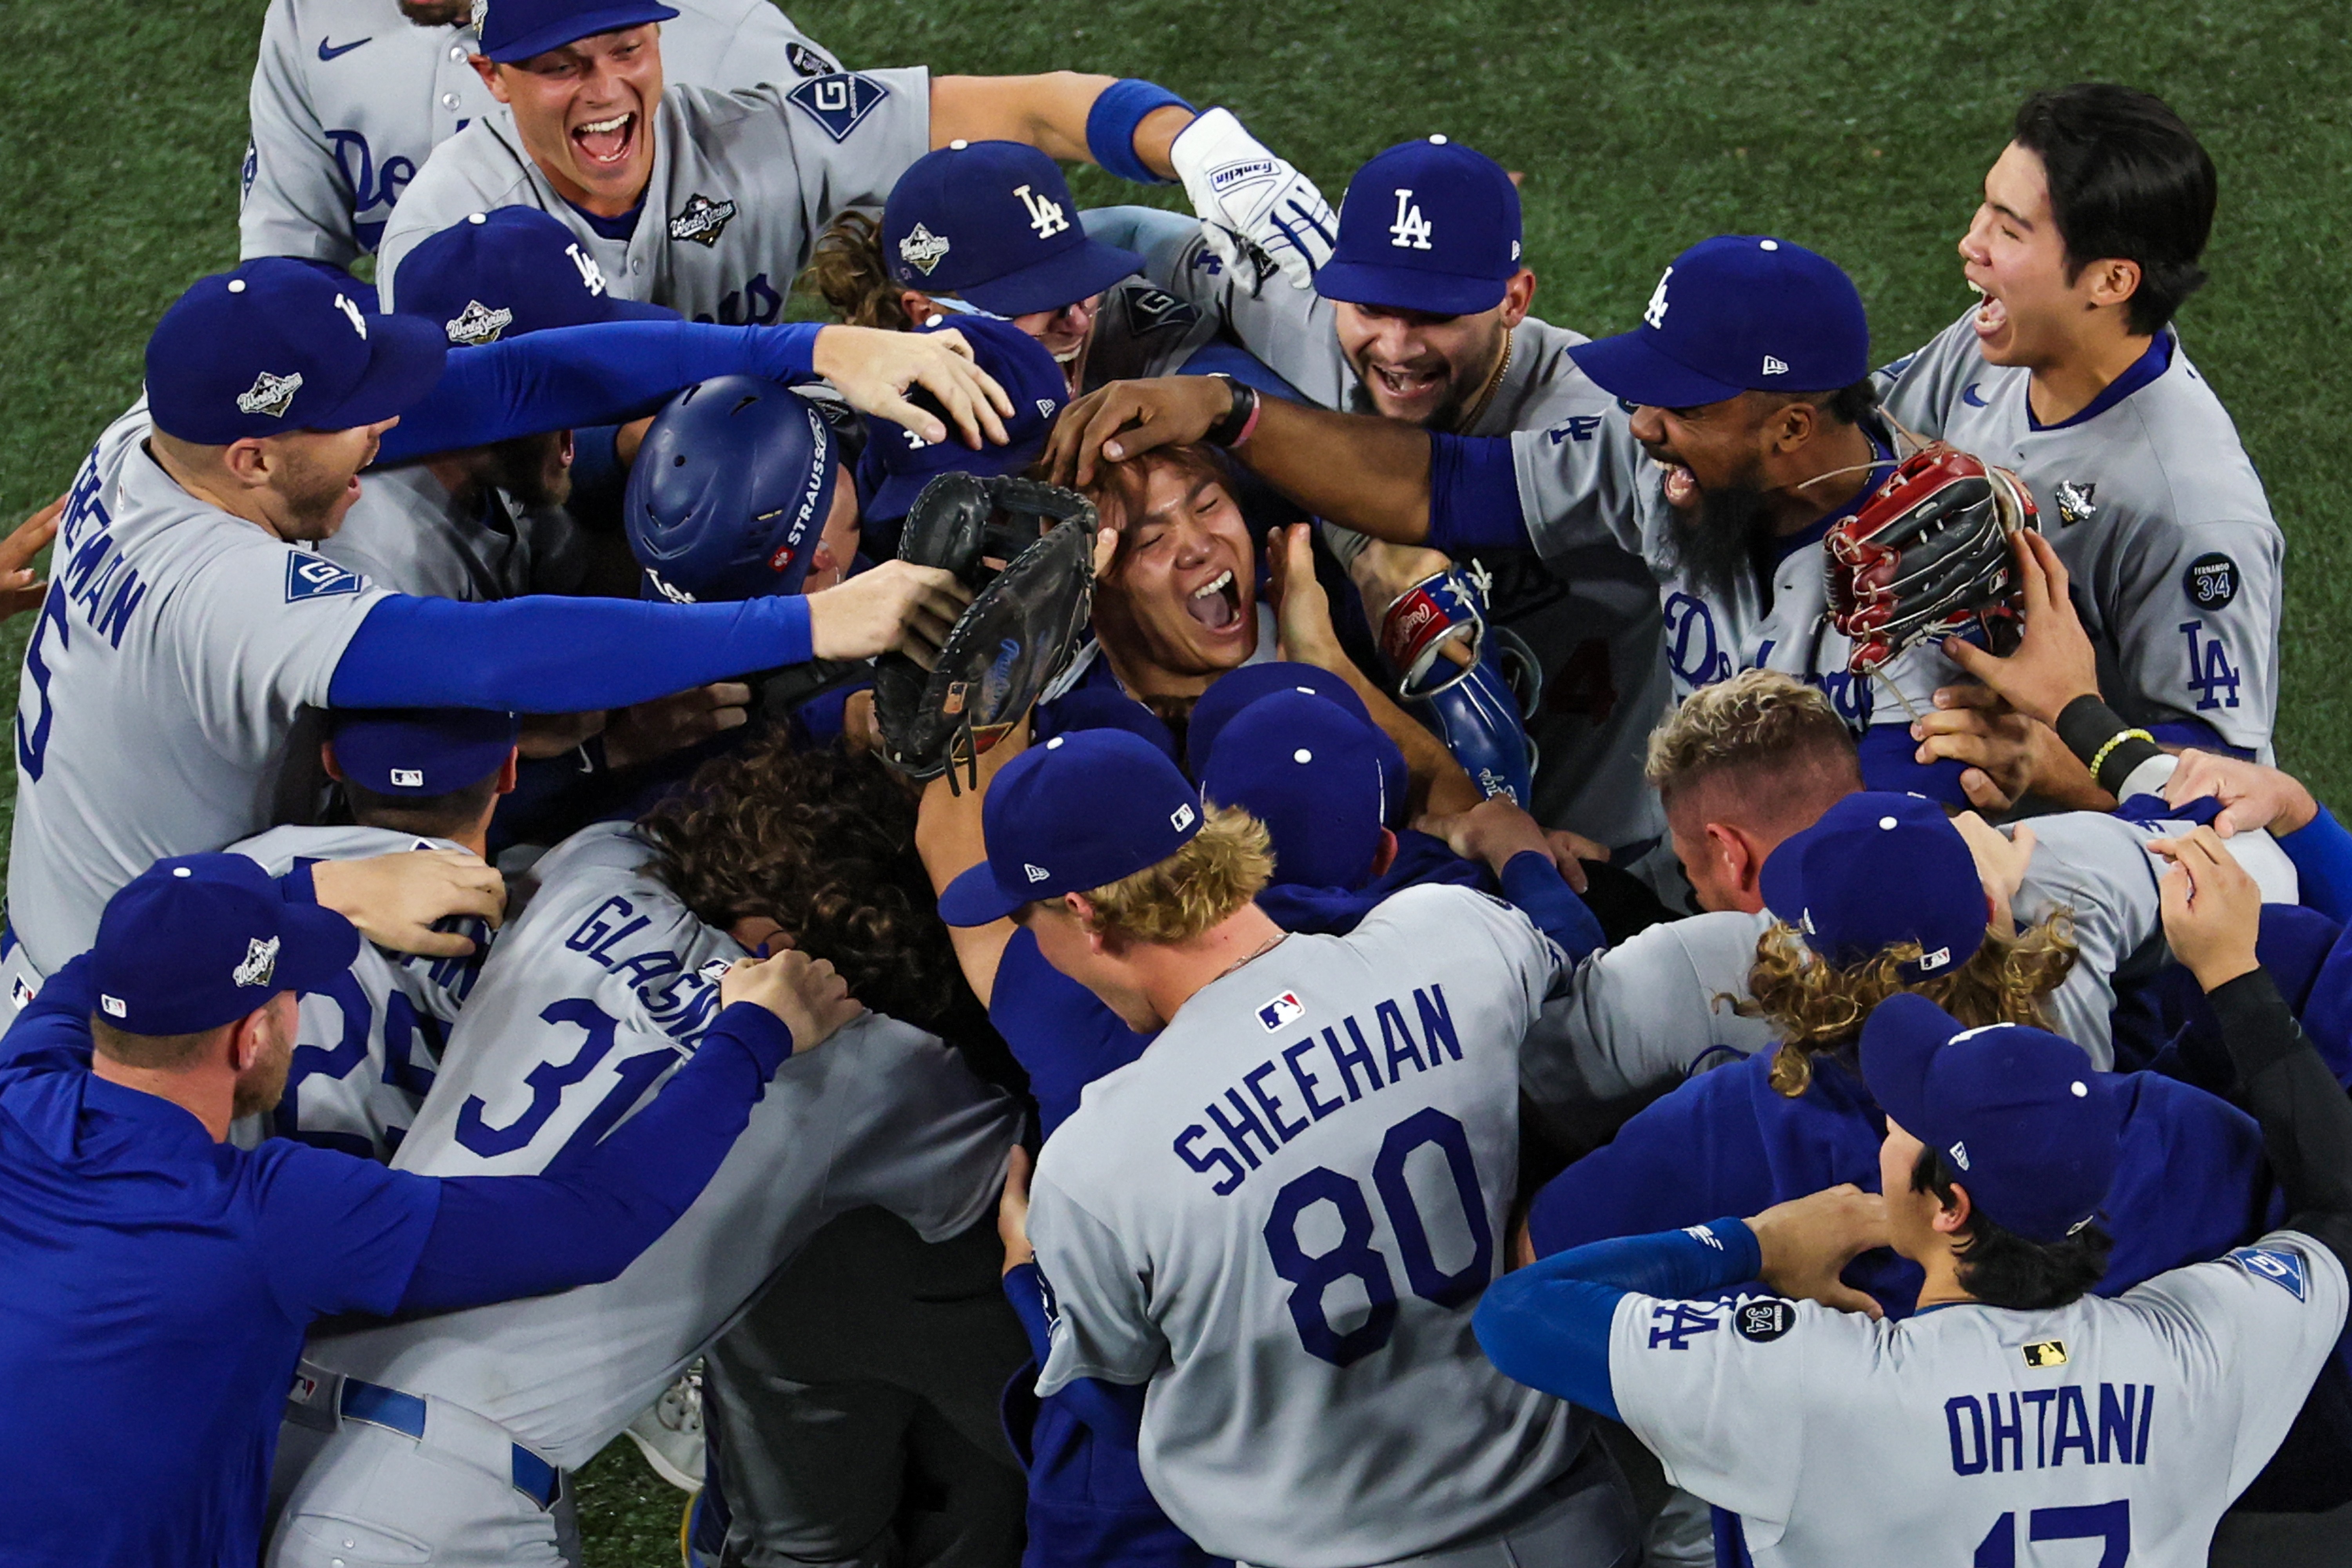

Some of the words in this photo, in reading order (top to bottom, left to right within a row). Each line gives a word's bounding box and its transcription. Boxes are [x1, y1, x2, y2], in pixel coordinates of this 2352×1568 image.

[1013, 184, 1069, 240] LA
[1390, 189, 1432, 250] LA
[566, 243, 606, 296] LA
[1644, 266, 1673, 329] LA
[788, 447, 826, 546] STRAUSS
[2196, 572, 2230, 602] 34
[2180, 621, 2239, 710] LA
[1173, 984, 1464, 1196] SHEEHAN
[1263, 1107, 1492, 1368] 80
[1746, 1307, 1773, 1333] 34
[1944, 1382, 2154, 1476] OHTANI
